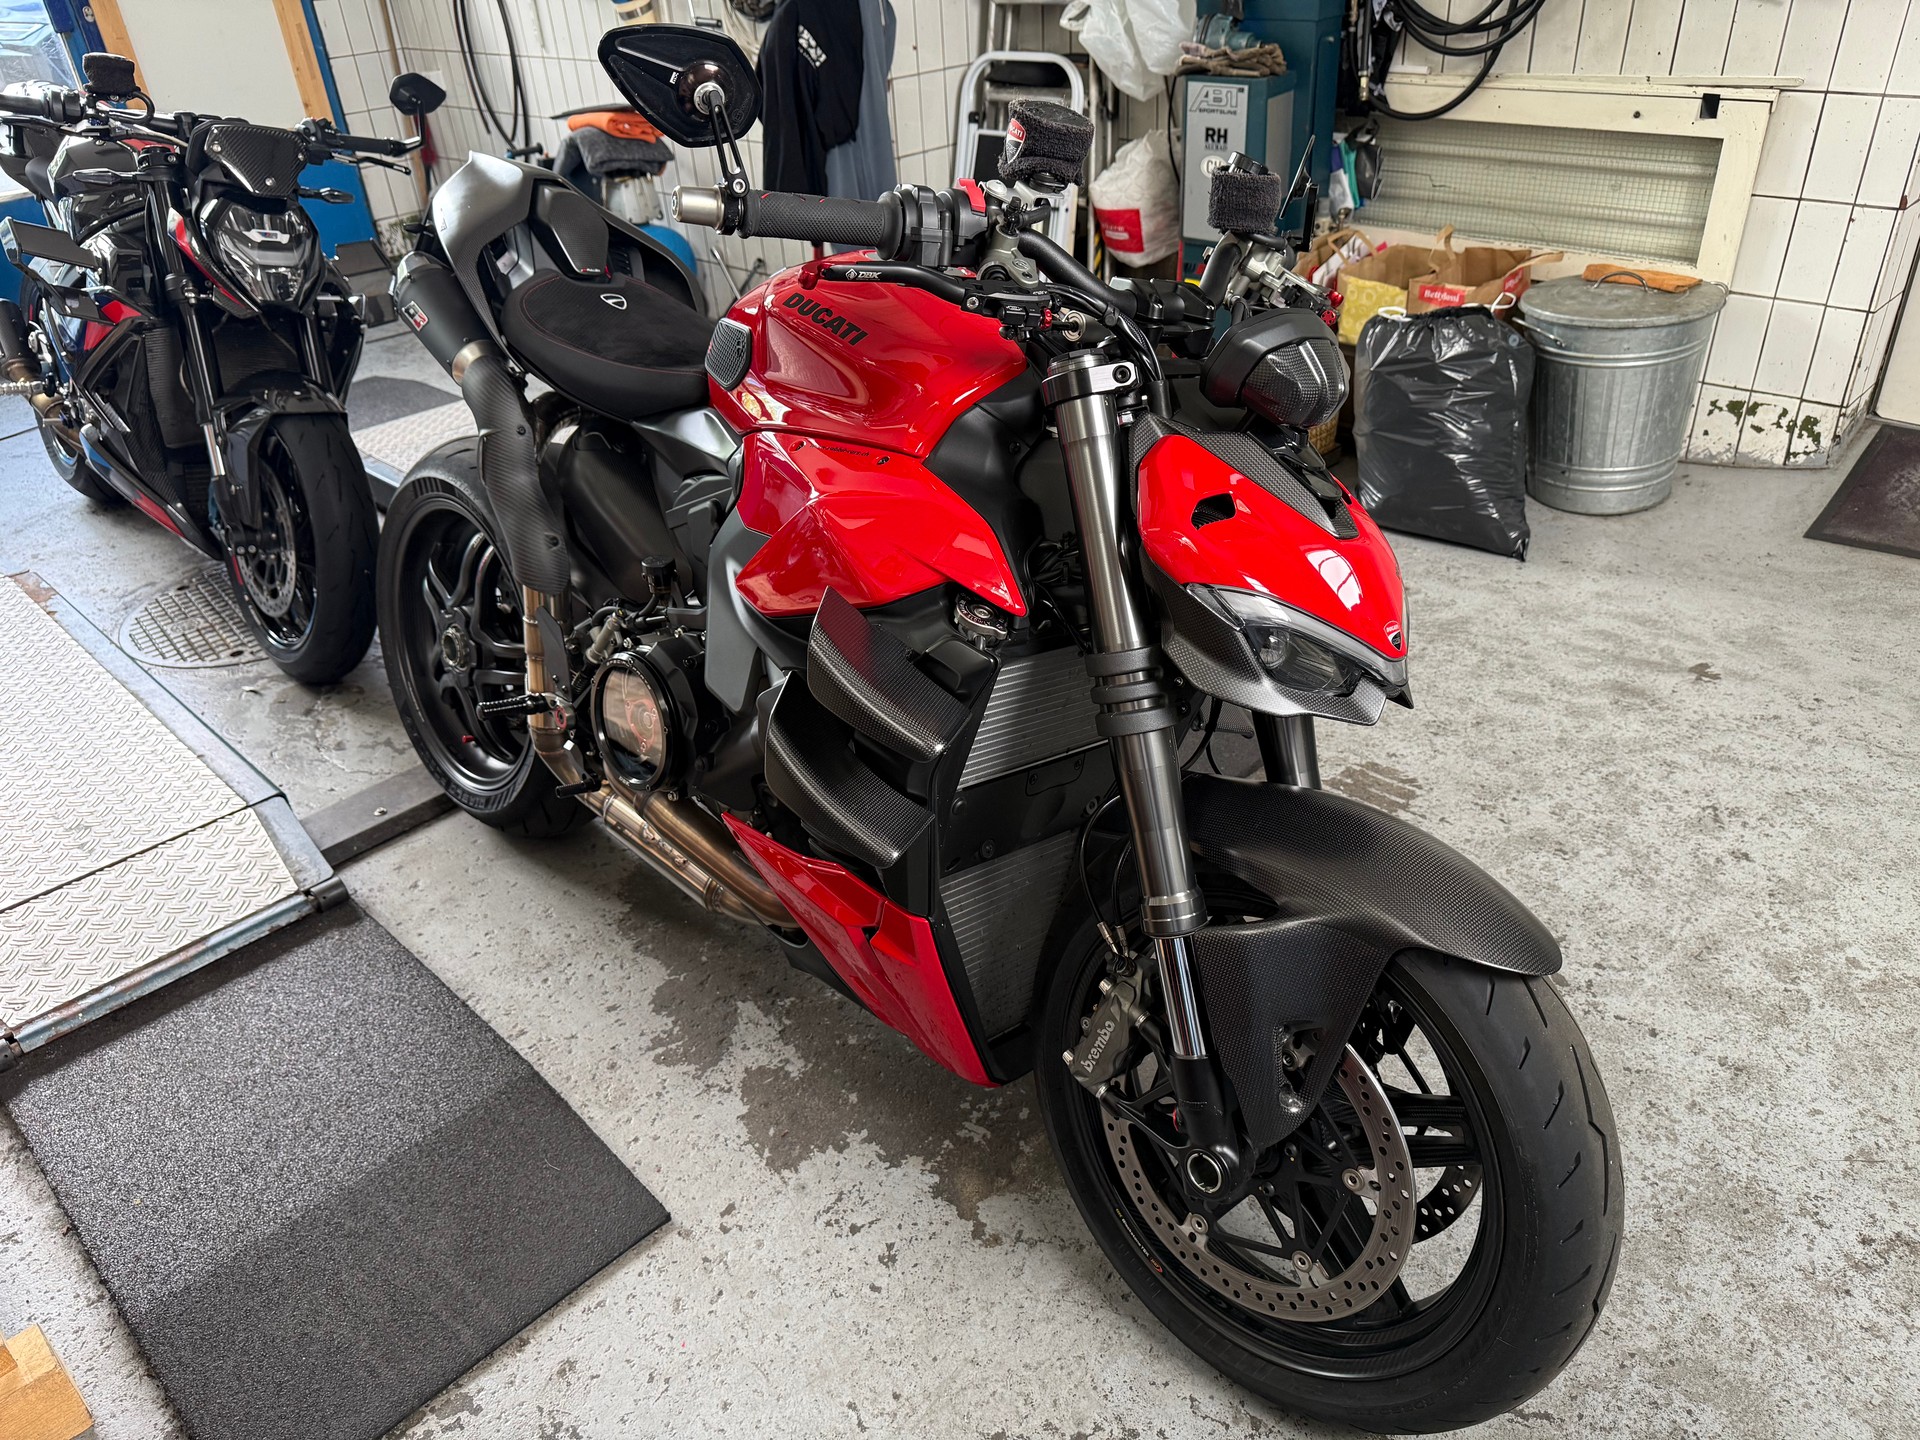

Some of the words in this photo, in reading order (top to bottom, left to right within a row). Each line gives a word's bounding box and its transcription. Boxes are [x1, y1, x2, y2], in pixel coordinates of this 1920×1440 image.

[1189, 85, 1240, 112] ABT
[1199, 107, 1238, 116] SPORTSLINE
[1205, 127, 1228, 144] RH
[858, 271, 882, 279] DBK
[782, 292, 869, 346] DUCATI
[1080, 1020, 1116, 1073] brembo
